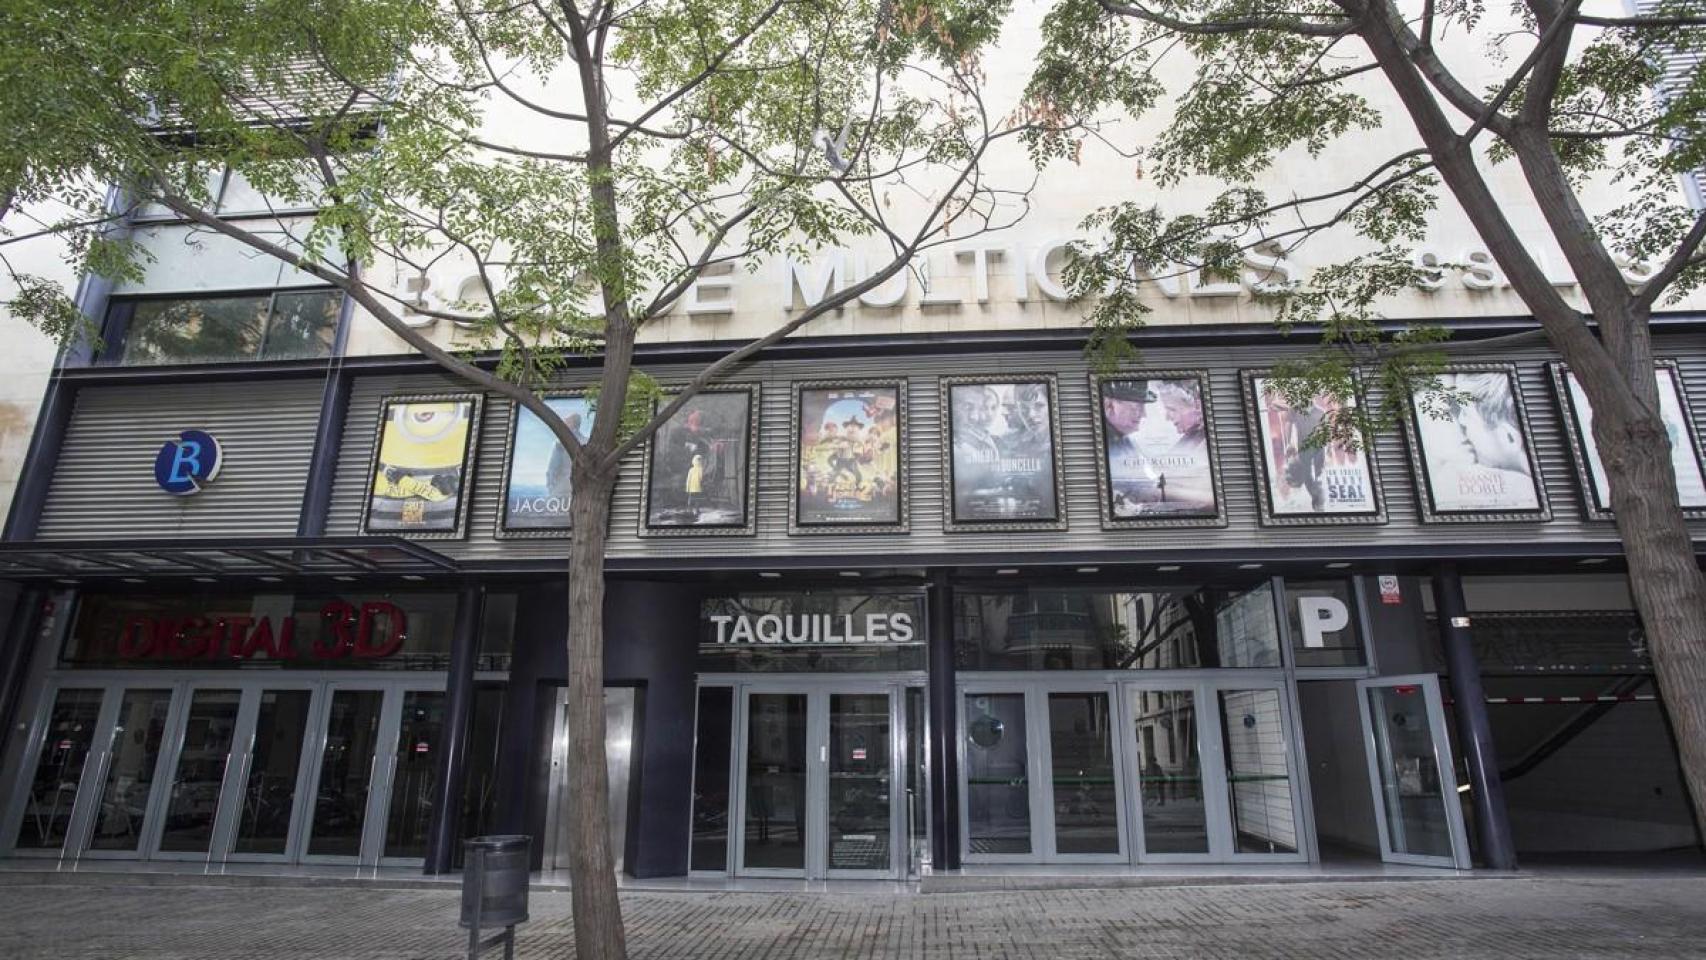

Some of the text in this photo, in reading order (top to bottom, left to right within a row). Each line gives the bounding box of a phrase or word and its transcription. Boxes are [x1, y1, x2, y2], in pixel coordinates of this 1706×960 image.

[511, 497, 572, 513] JACQU
[1328, 485, 1365, 499] SEAL
[118, 600, 407, 660] DIGITAL 3D
[710, 612, 914, 643] TAQUILLES
[1298, 597, 1349, 648] P
